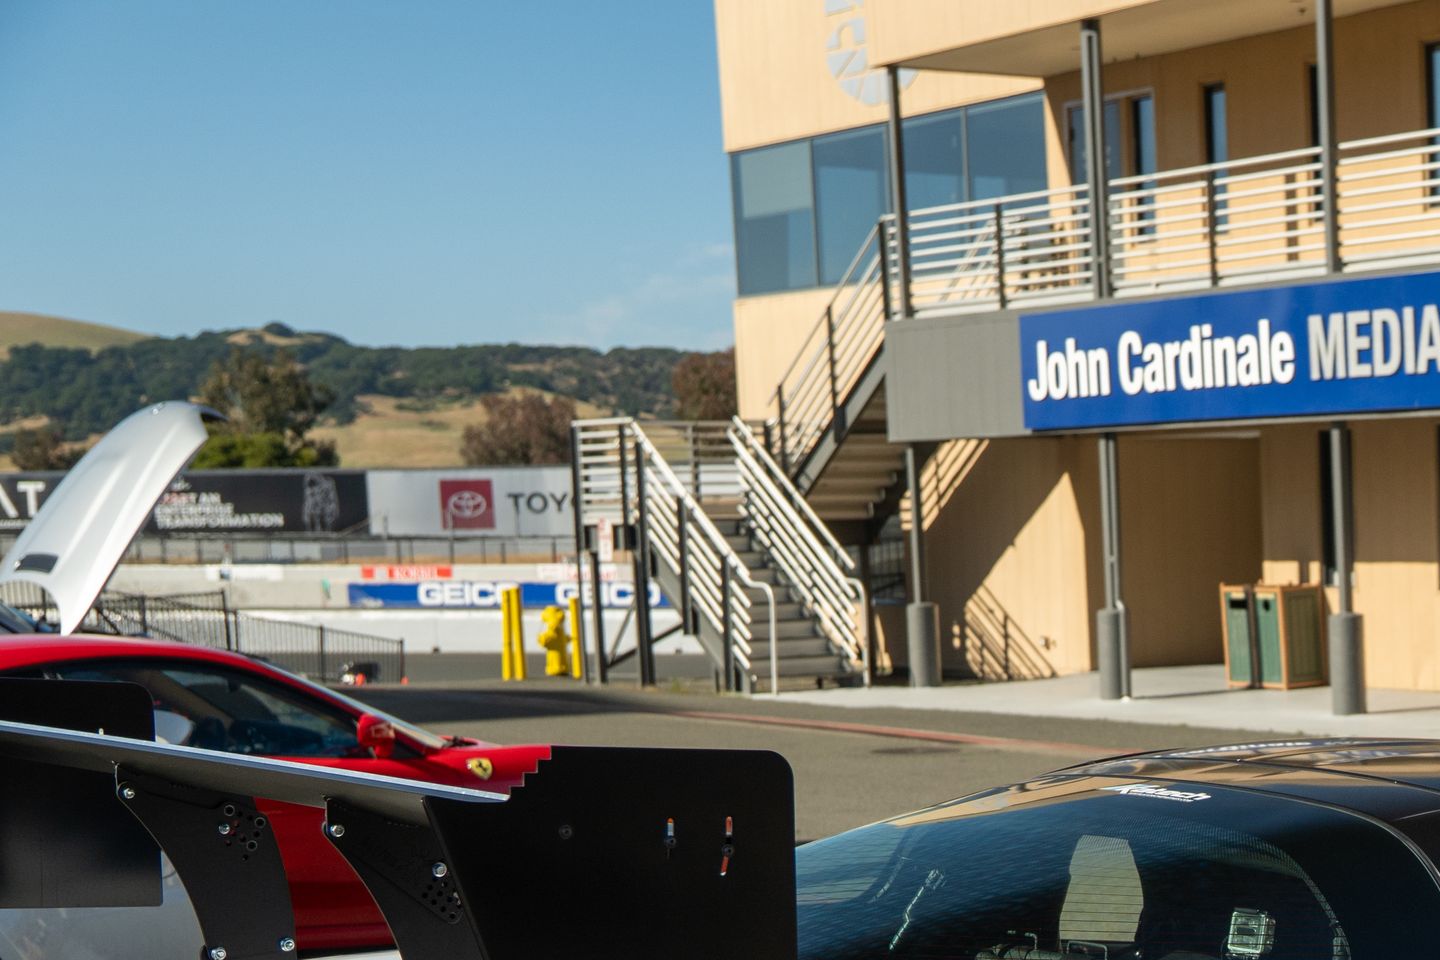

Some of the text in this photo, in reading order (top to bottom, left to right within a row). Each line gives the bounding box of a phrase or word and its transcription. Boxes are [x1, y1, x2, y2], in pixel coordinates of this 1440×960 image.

[1028, 337, 1111, 401] John
[1117, 318, 1296, 396] Cardinale
[507, 492, 575, 514] TOY
[156, 513, 285, 529] TRANSFORMATION
